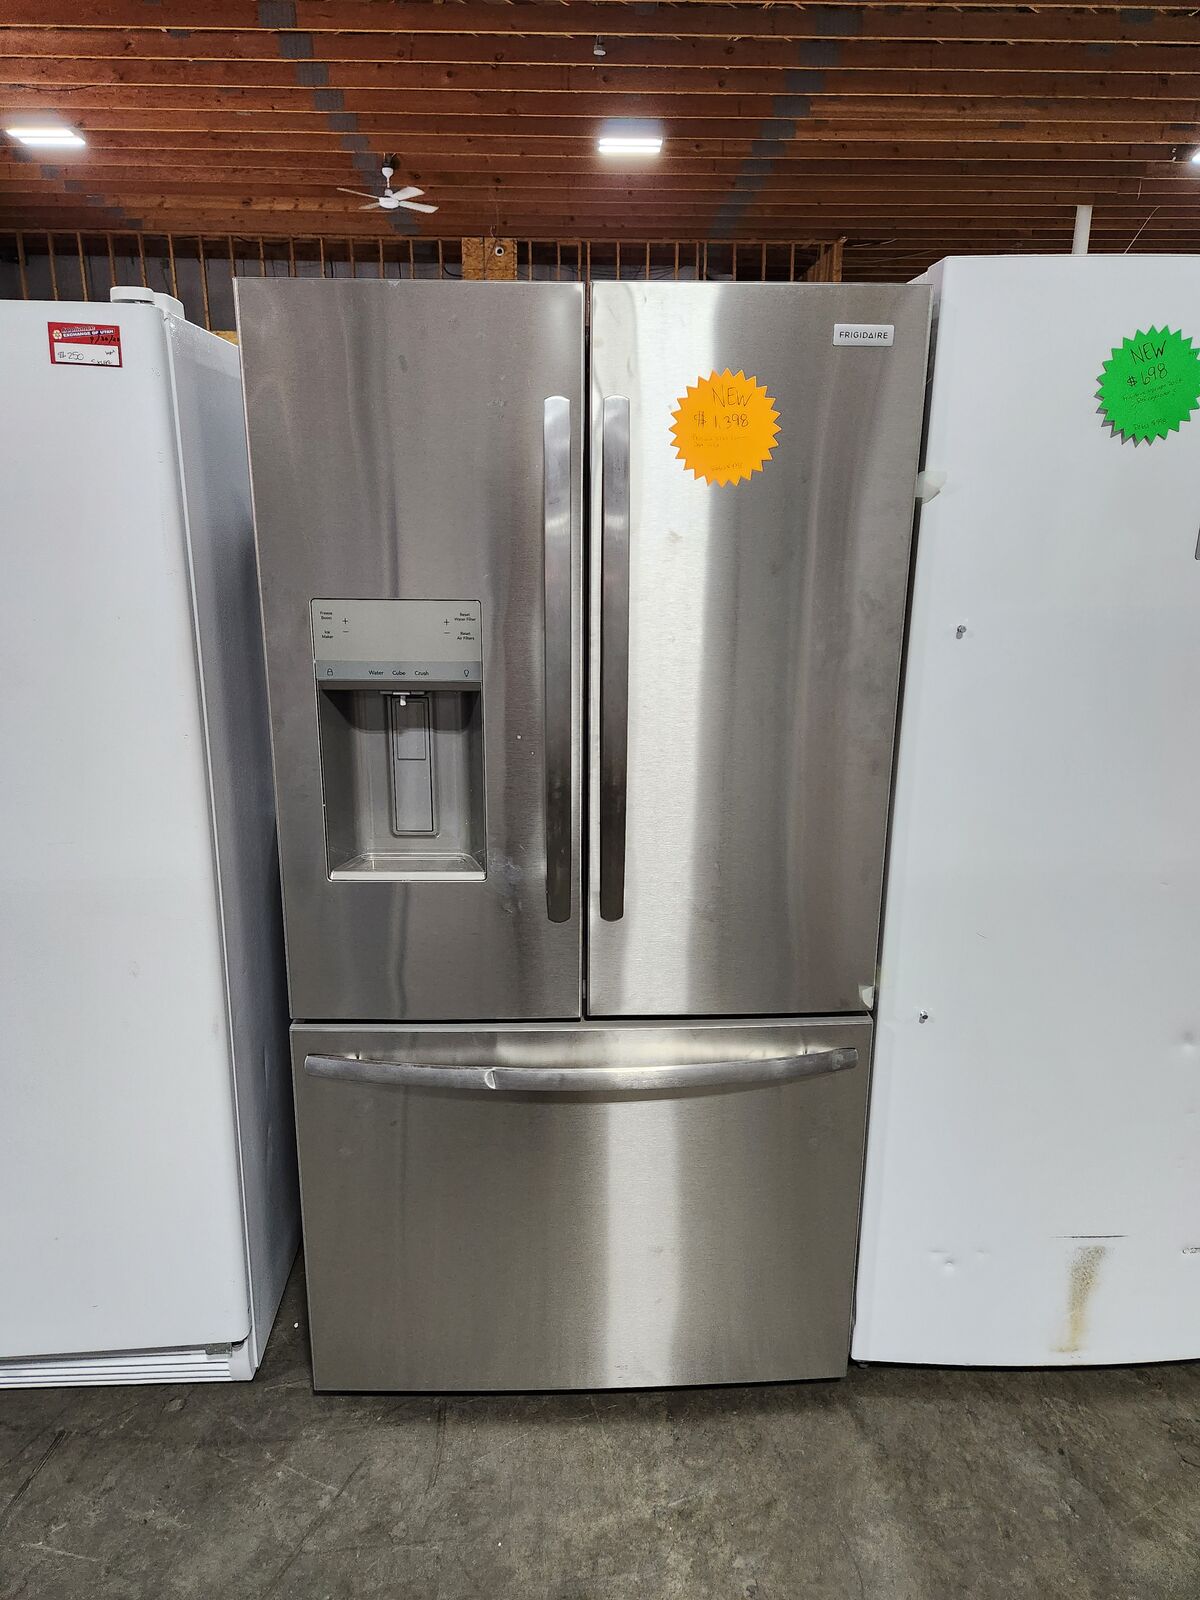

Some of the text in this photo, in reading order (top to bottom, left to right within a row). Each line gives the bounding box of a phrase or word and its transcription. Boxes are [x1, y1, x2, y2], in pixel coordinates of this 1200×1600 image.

[839, 331, 889, 340] FRIGIDAIRE
[1130, 339, 1167, 365] NEW
[712, 383, 753, 408] NEW
